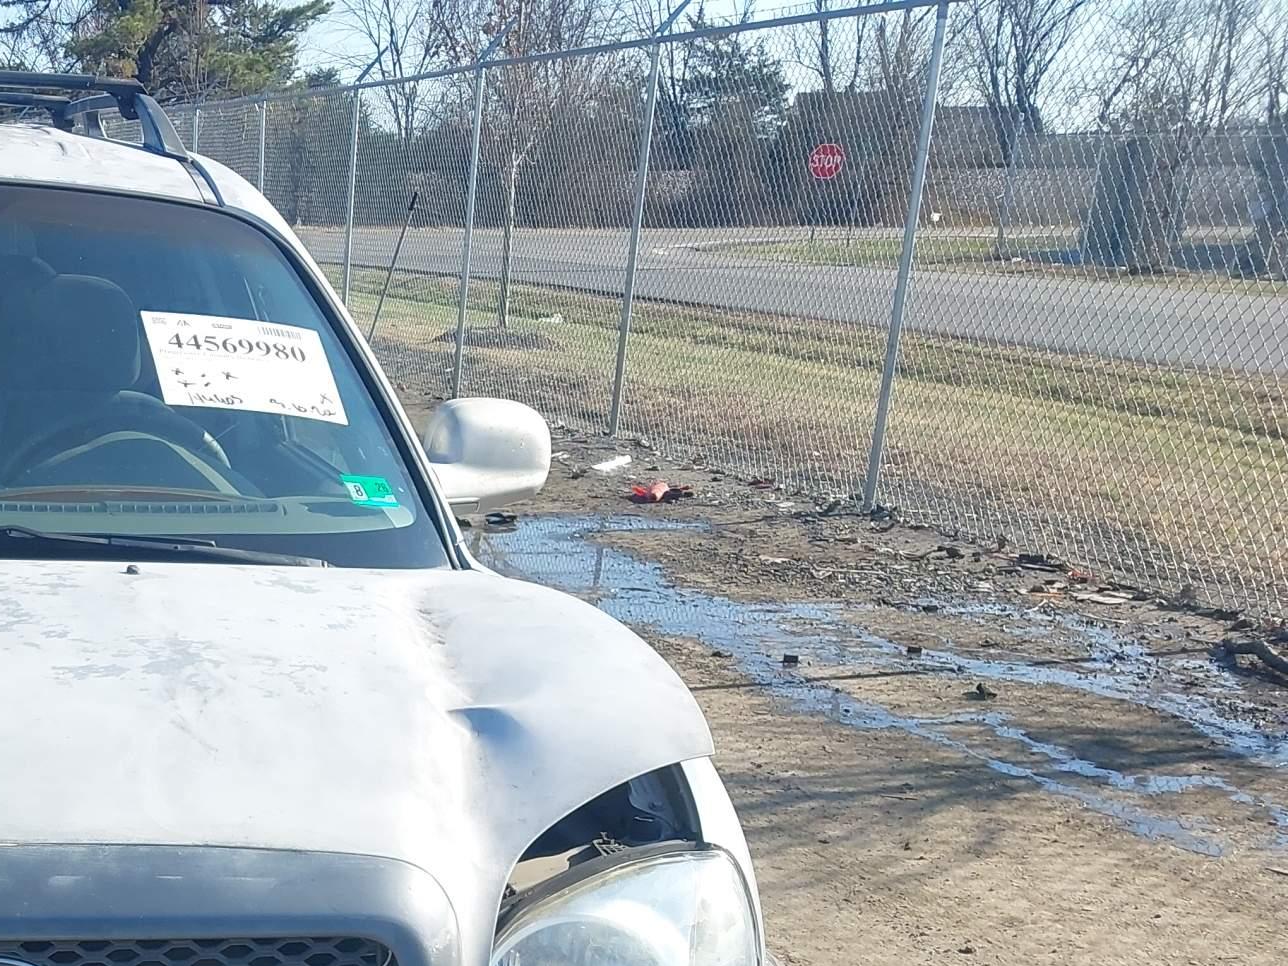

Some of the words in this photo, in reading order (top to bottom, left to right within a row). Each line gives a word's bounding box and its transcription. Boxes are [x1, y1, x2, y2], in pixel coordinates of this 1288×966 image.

[812, 155, 841, 168] STOP
[168, 332, 306, 362] 44569980
[353, 484, 363, 497] 8
